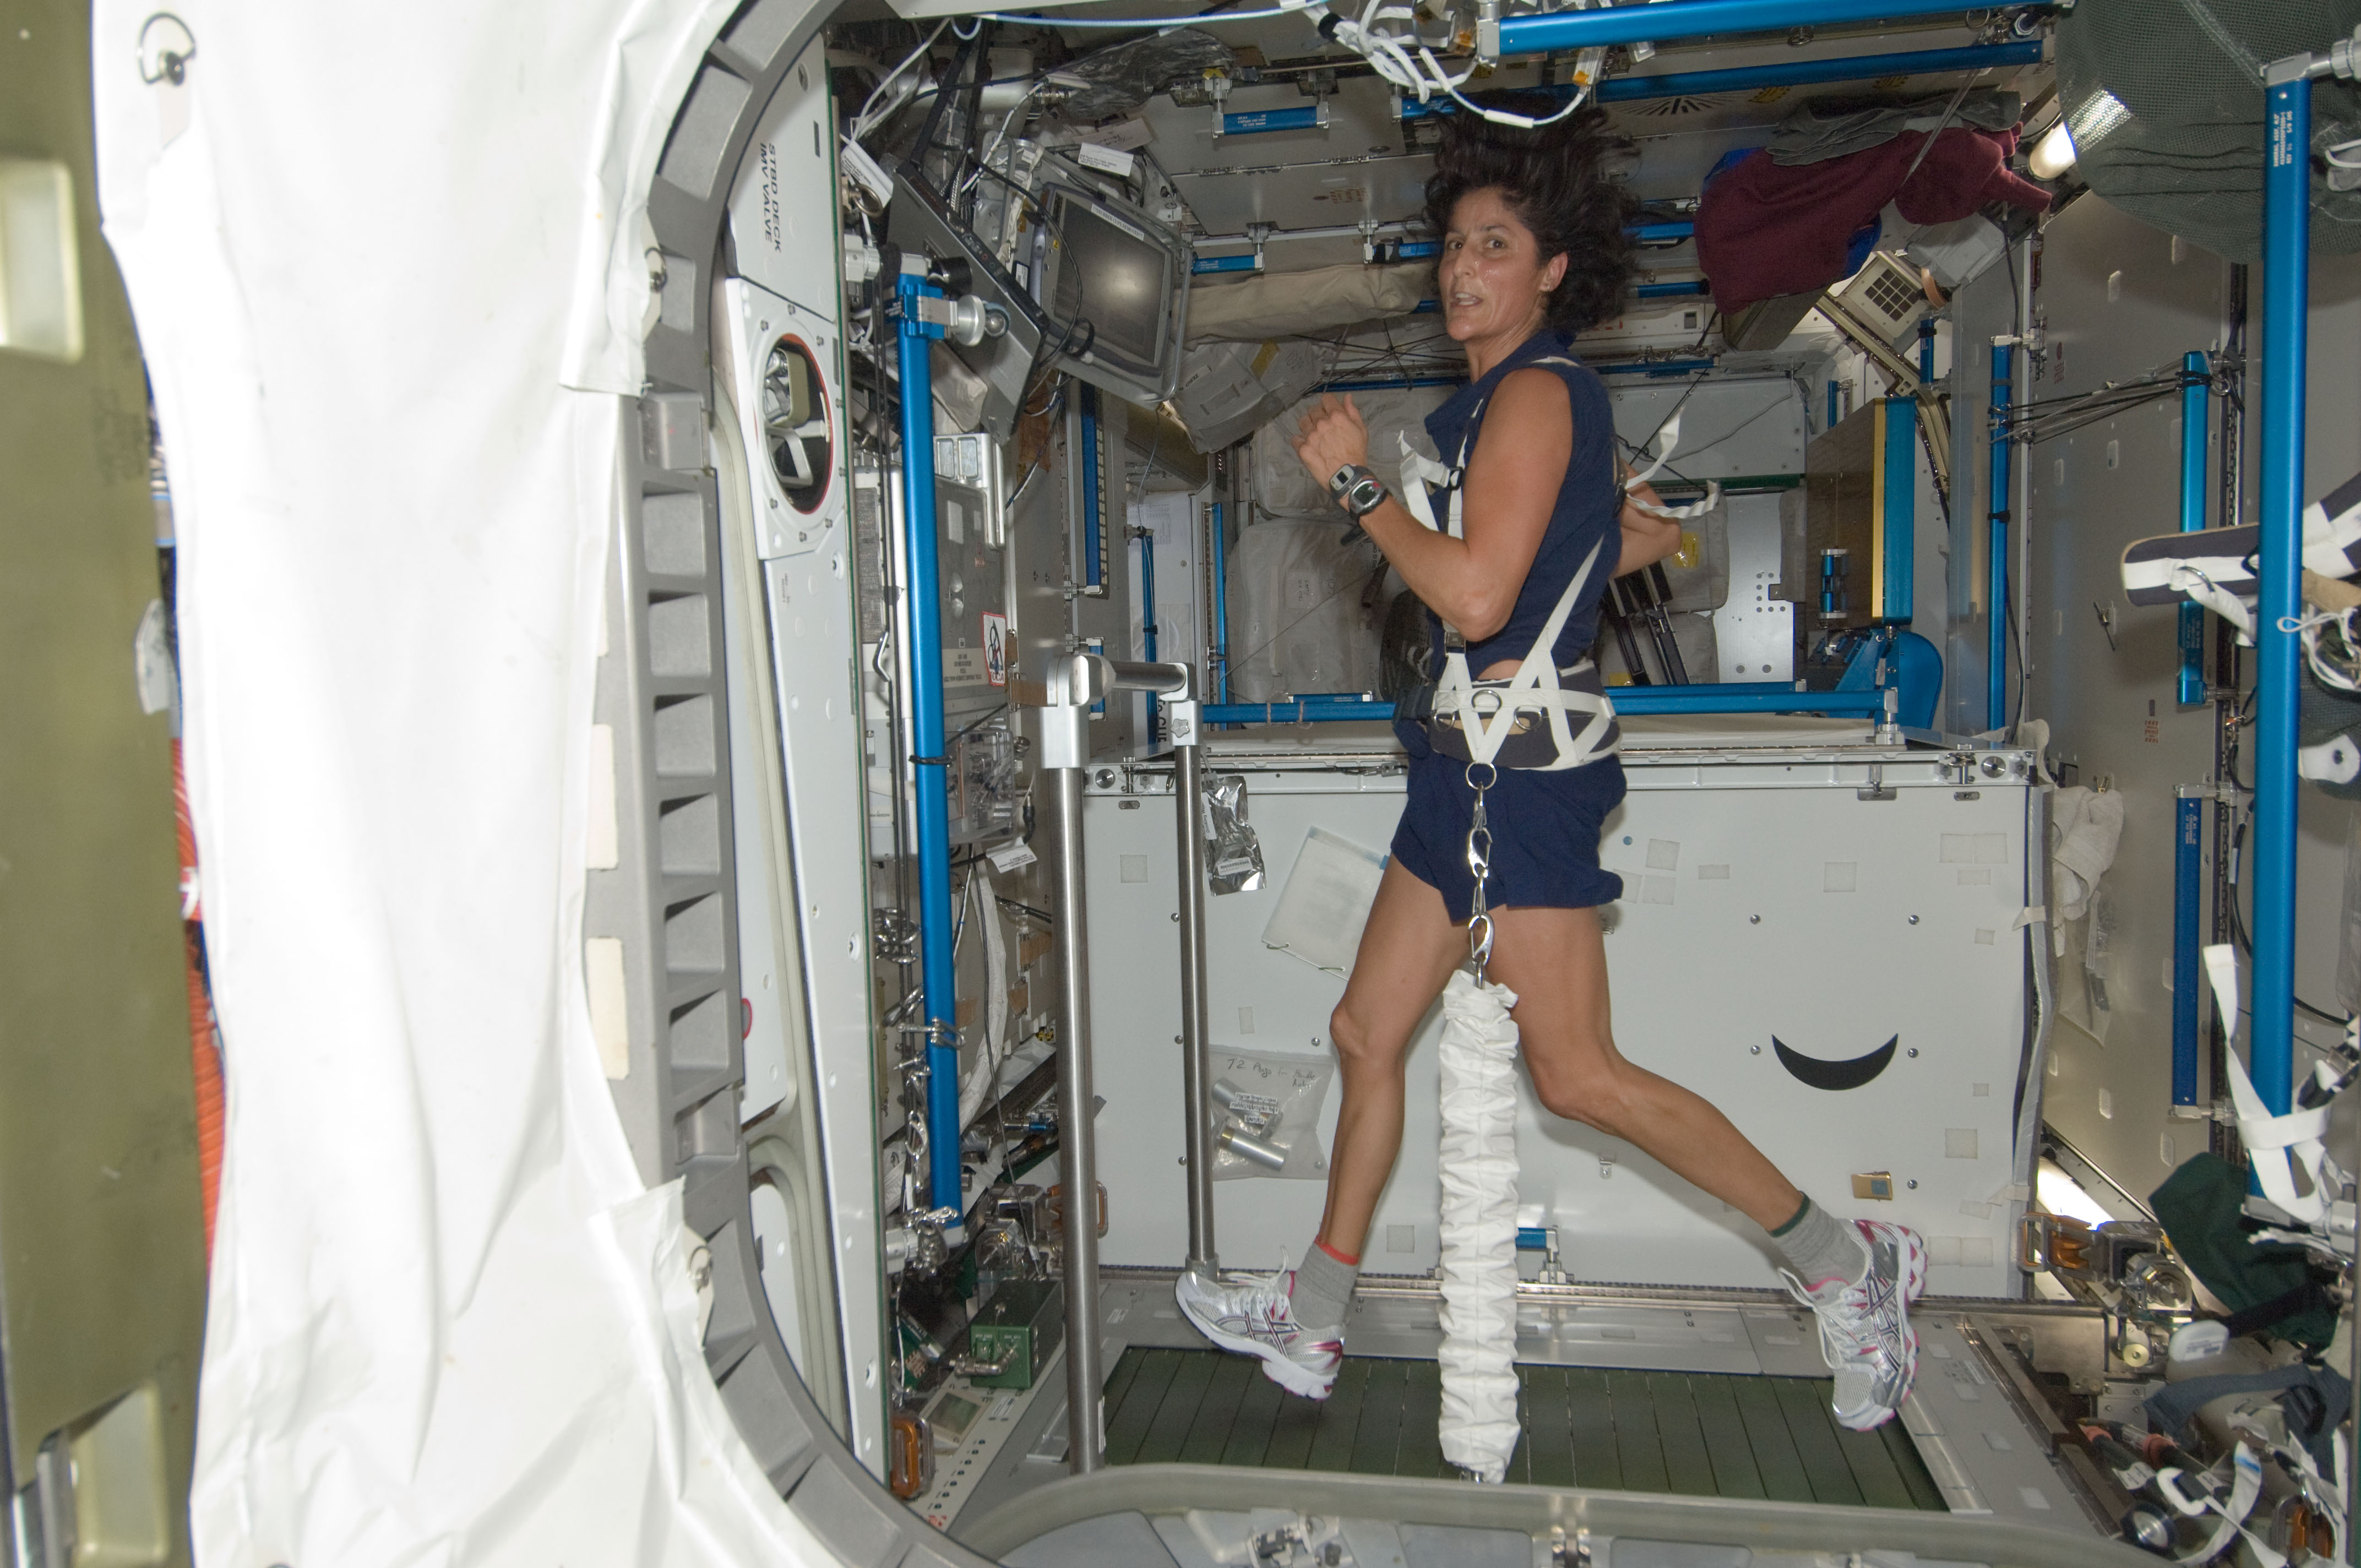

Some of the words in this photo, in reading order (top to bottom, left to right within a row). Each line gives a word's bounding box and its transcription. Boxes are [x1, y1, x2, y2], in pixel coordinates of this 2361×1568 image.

[760, 142, 768, 178] IMV
[769, 143, 777, 194] STBD
[763, 184, 772, 243] VALVE
[772, 199, 781, 253] DECK
[1227, 1058, 1245, 1070] T2
